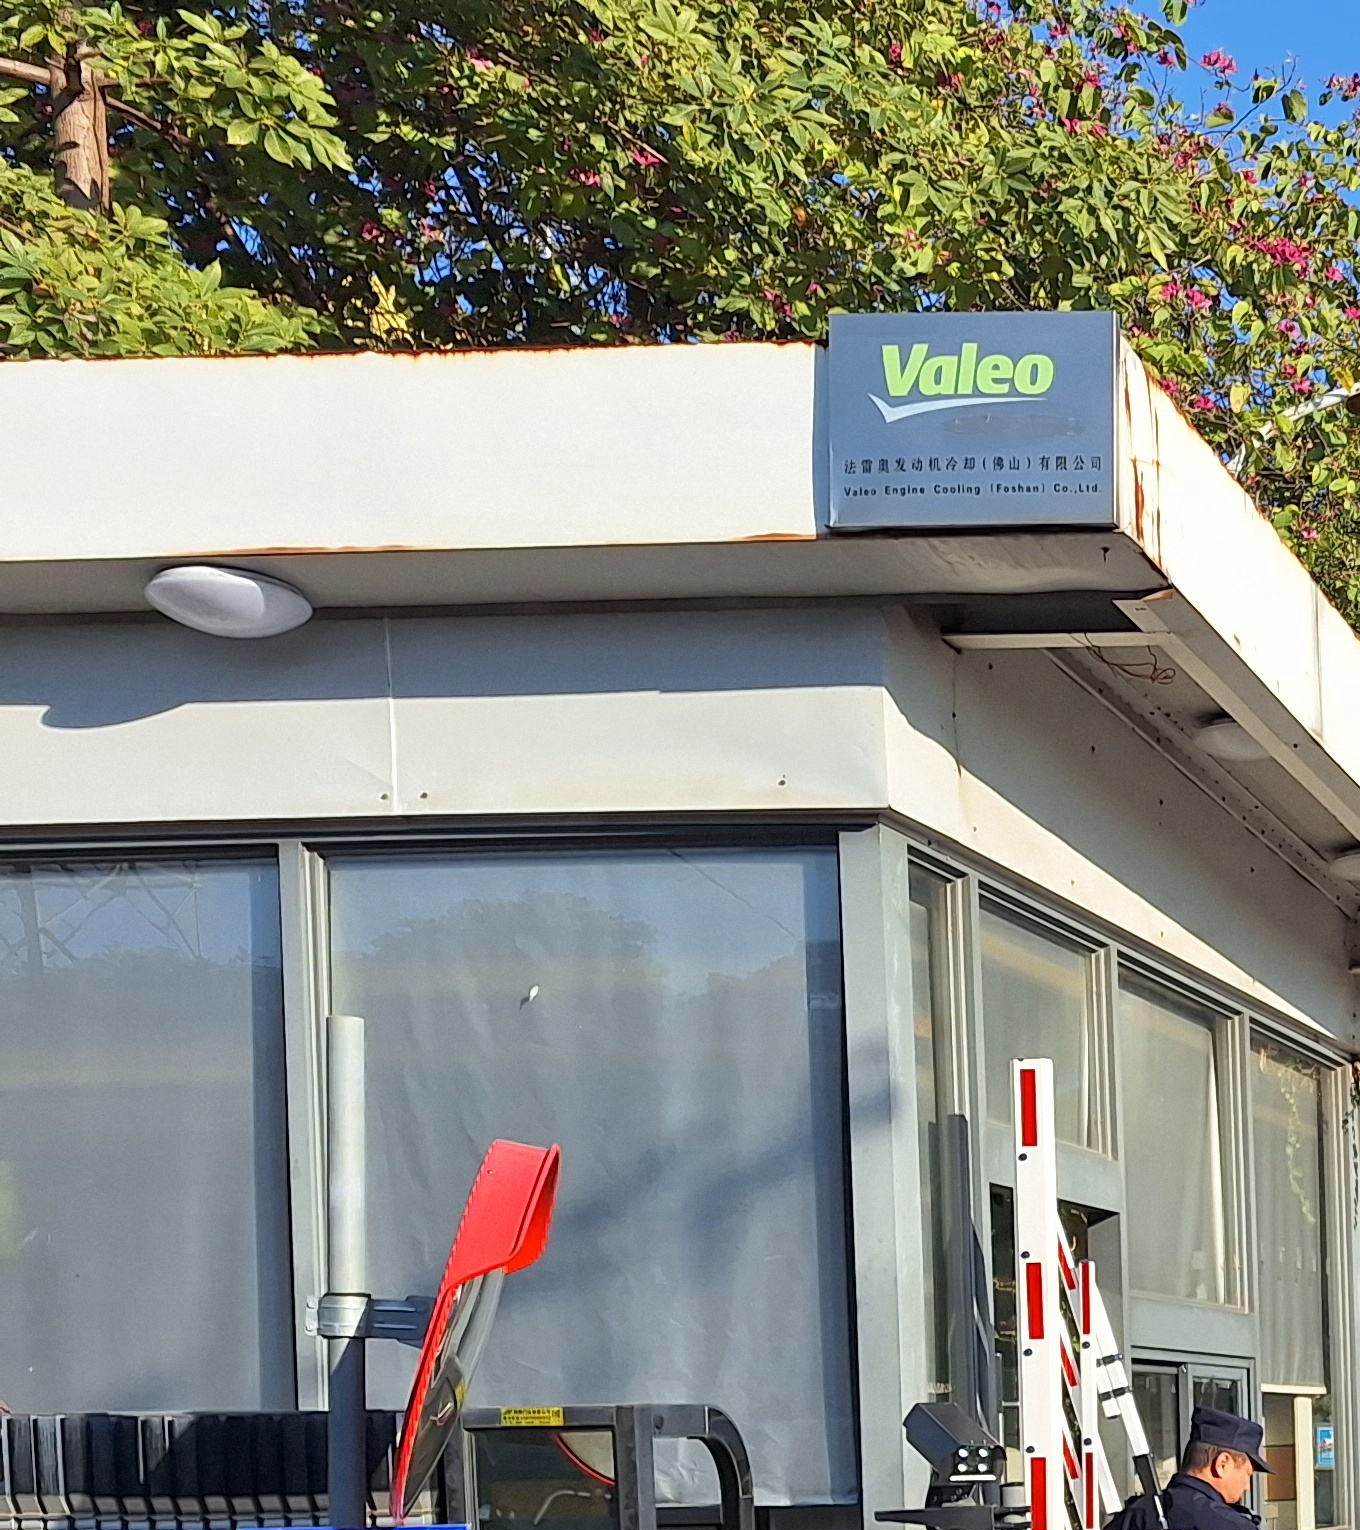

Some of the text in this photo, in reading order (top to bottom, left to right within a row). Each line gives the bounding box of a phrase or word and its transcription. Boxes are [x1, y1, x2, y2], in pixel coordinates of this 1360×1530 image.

[881, 343, 1055, 397] Valeo
[843, 485, 877, 497] Valeo
[884, 484, 926, 497] Engine
[933, 483, 981, 496] Cooling
[990, 482, 1046, 495] (Foshan)
